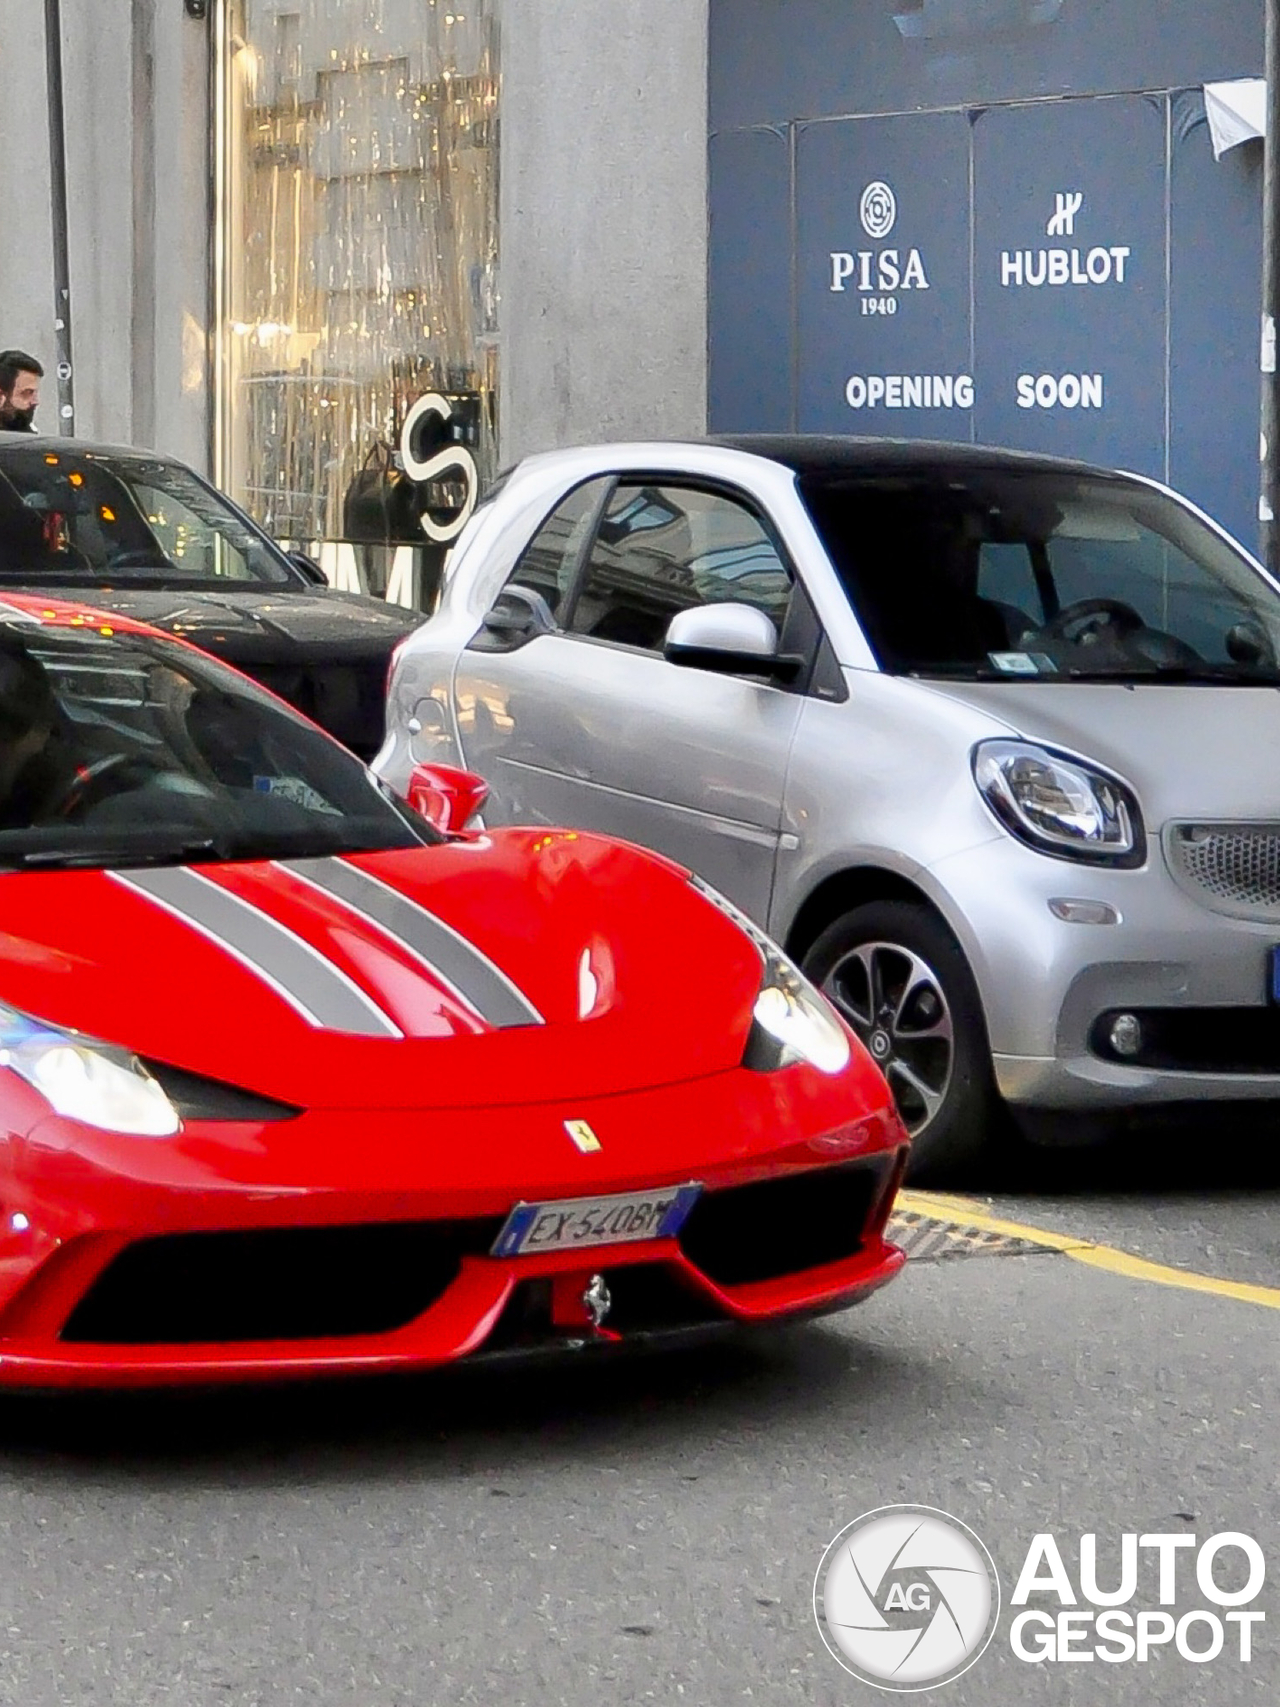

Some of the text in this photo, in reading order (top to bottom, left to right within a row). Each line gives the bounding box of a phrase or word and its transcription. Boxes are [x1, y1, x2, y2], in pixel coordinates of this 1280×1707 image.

[830, 249, 929, 291] PISA
[1001, 246, 1130, 286] HUBLOT
[861, 297, 897, 315] 1940
[846, 374, 1103, 408] OPENING SOON
